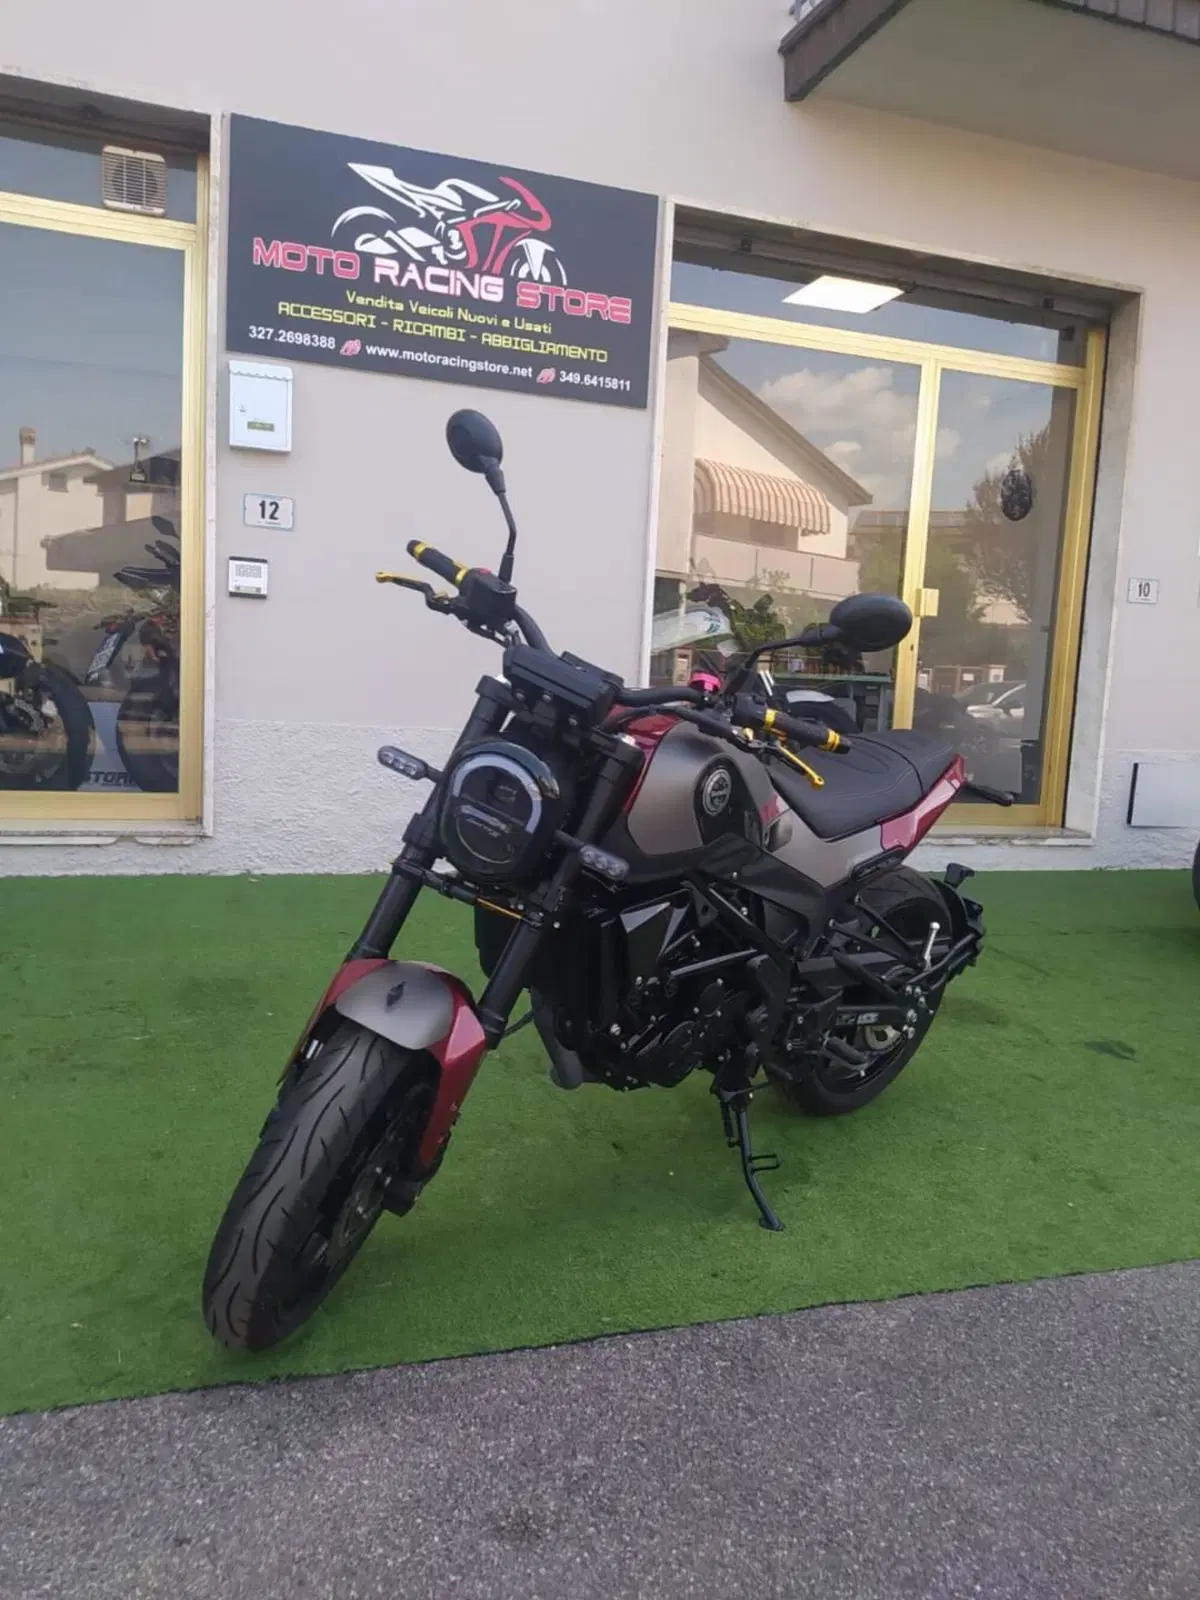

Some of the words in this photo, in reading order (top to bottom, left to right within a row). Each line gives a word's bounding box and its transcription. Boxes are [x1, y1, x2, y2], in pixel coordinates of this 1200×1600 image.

[252, 236, 361, 280] MOTO
[373, 256, 505, 303] RACING
[515, 280, 632, 324] STORE
[277, 301, 377, 329] ACCESSORI
[393, 318, 466, 342] RICAMBI
[481, 332, 608, 363] ABBIGLIAMENTO
[346, 289, 404, 311] Vendita
[408, 299, 453, 319] Veicoli
[457, 307, 498, 326] Nuovi
[501, 318, 511, 328] e
[514, 316, 552, 335] Usati
[248, 325, 336, 350] 327.2698388
[365, 344, 533, 379] www.motoracingstore.net
[559, 370, 632, 392] 349.6415811
[259, 499, 280, 521] 12
[1138, 581, 1151, 598] 10
